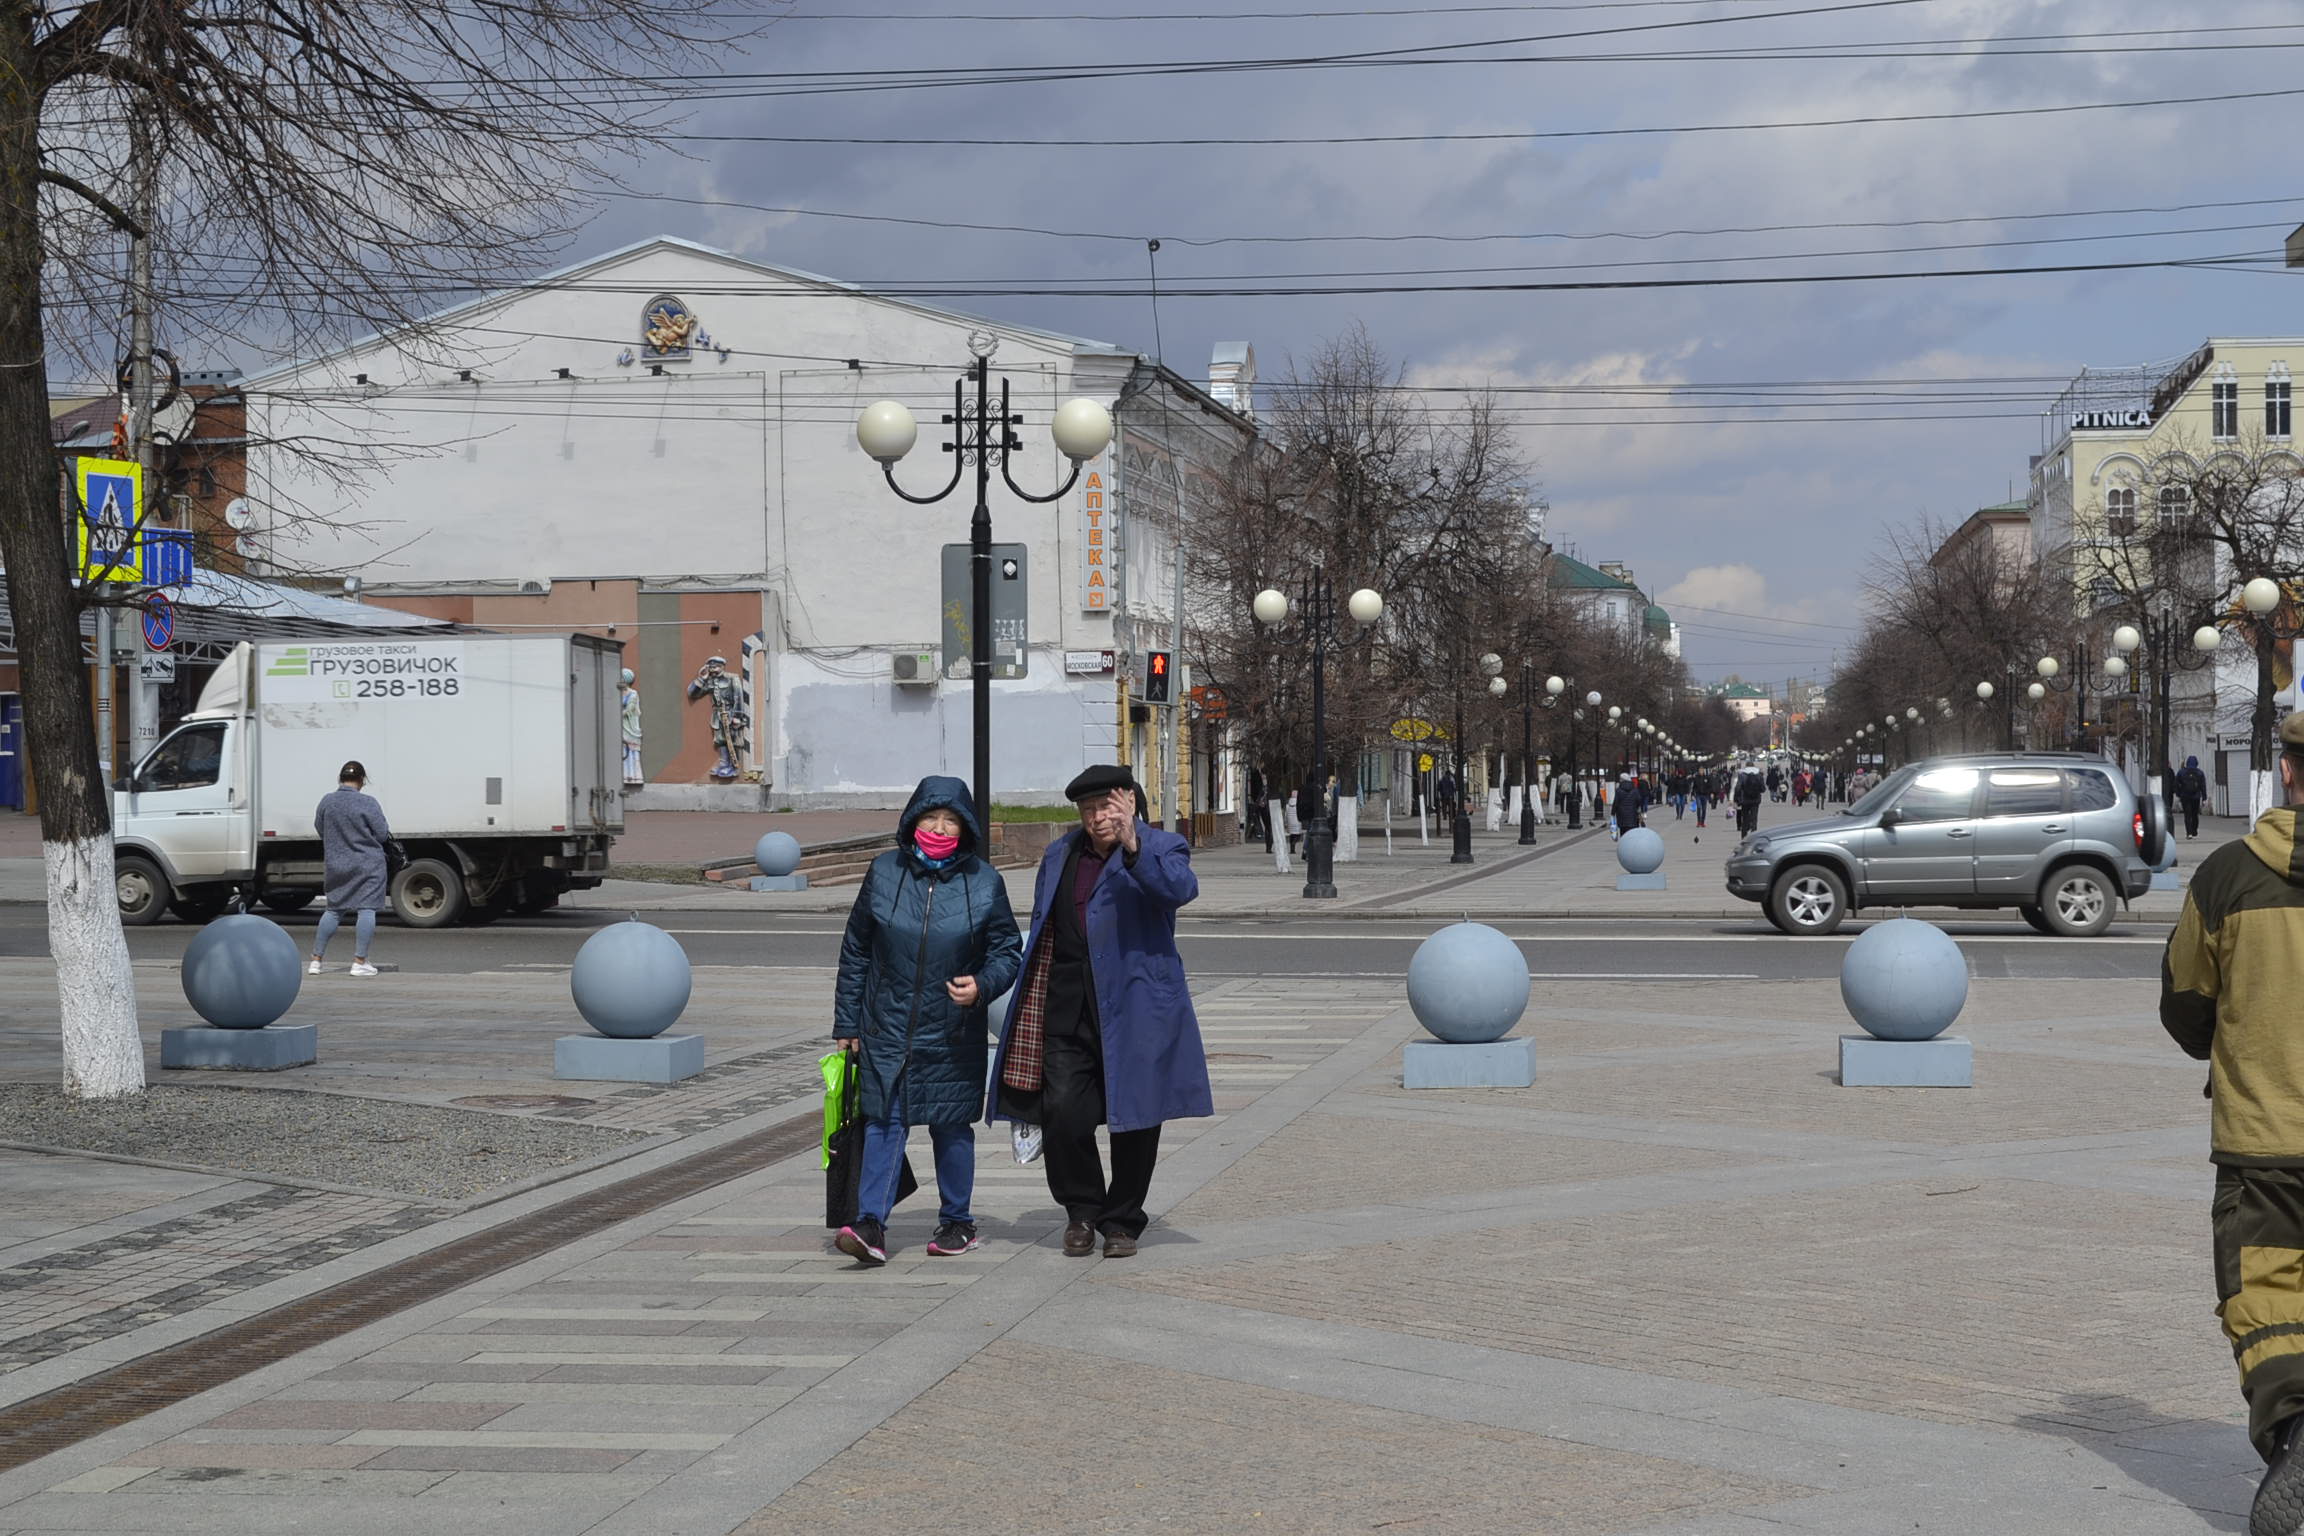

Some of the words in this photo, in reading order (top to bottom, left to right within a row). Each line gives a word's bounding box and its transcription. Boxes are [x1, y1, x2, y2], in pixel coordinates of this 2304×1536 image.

[2071, 410, 2152, 427] PITNICA
[1086, 472, 1105, 587] АПТЕКА
[310, 646, 375, 657] грузовое
[379, 645, 417, 655] такси
[310, 657, 458, 675] ГРУЗОВИЧОК
[1102, 654, 1113, 668] 60
[356, 678, 459, 697] 258-188
